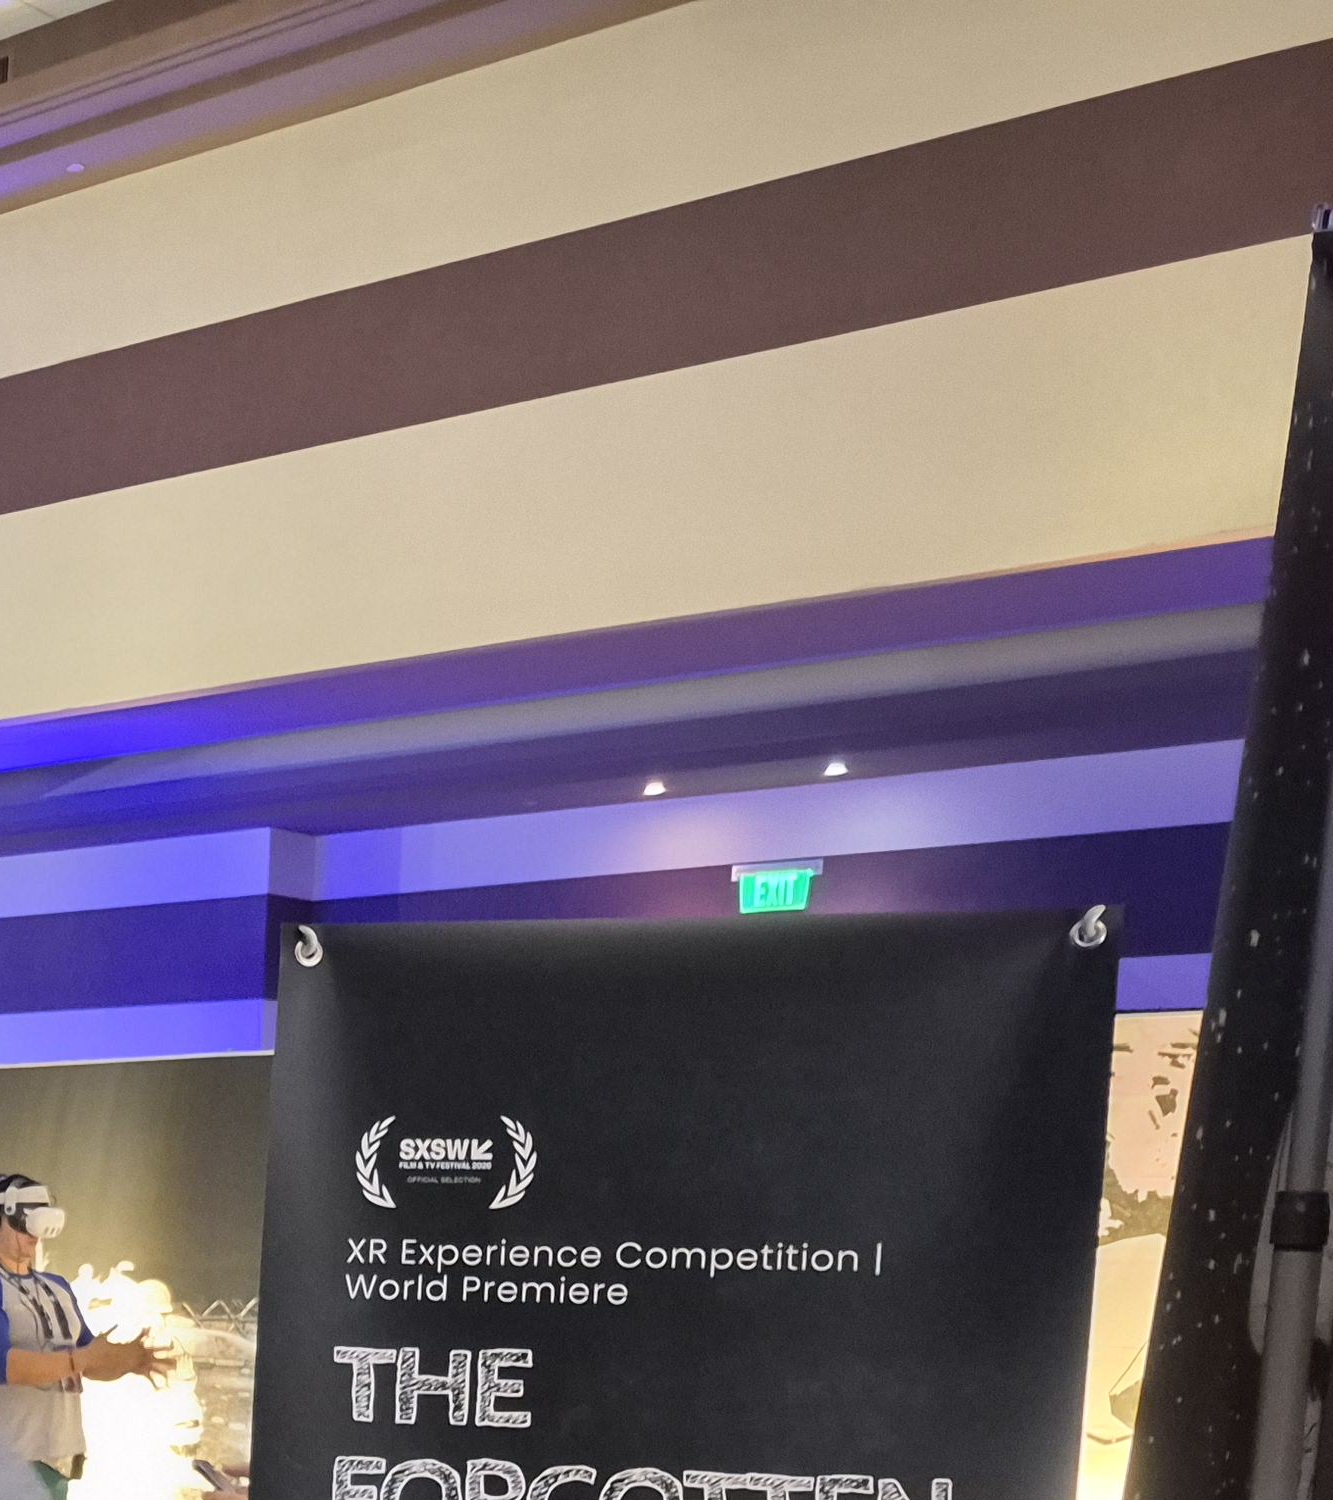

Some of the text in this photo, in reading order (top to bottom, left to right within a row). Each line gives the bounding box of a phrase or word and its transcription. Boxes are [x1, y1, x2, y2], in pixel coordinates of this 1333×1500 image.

[754, 873, 798, 907] EXIT
[399, 1138, 470, 1160] SXSW
[398, 1161, 417, 1170] FILM
[425, 1161, 436, 1170] TV
[436, 1161, 471, 1170] FESTIVAL
[406, 1175, 482, 1184] OFFICIAL SELECTION
[346, 1238, 387, 1265] XR
[401, 1239, 602, 1272] Experience
[615, 1241, 859, 1278] Competition
[344, 1275, 629, 1305] World Premiere
[334, 1347, 533, 1427] THE
